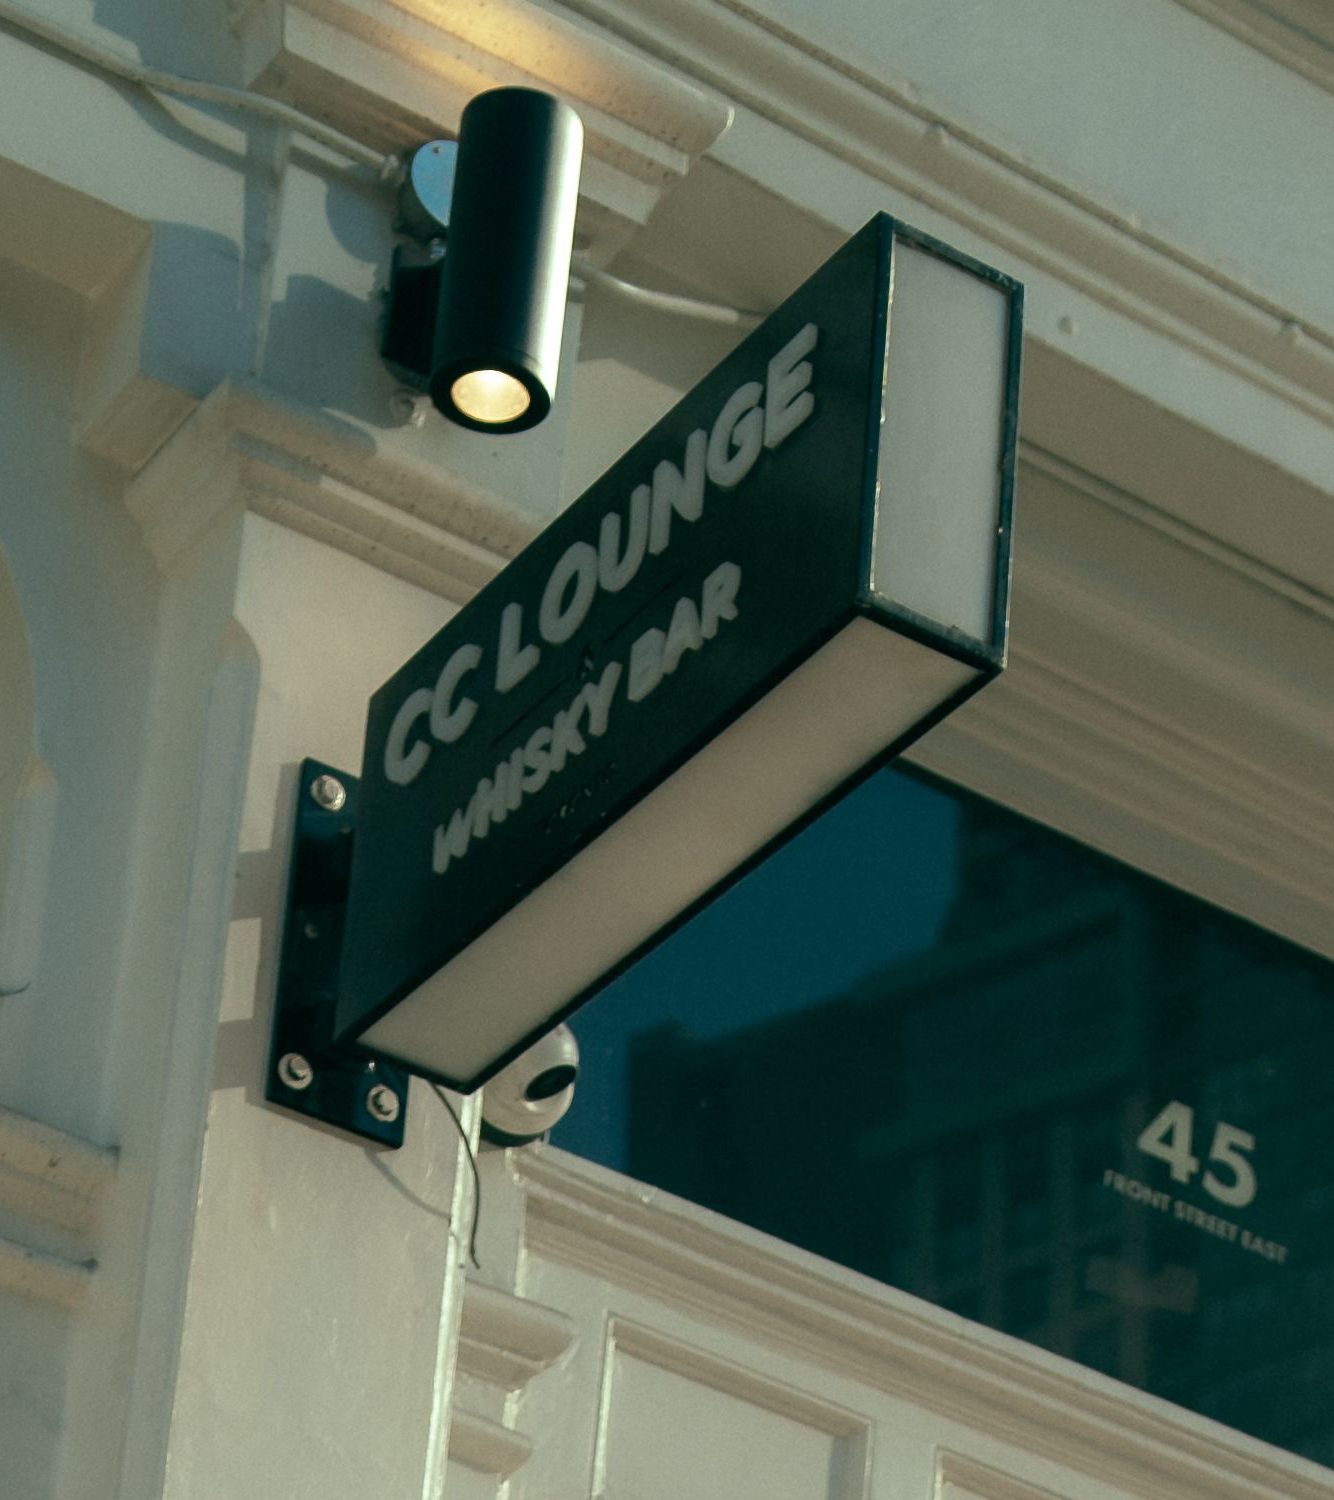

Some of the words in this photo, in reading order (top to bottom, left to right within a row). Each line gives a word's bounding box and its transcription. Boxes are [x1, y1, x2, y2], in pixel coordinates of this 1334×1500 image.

[383, 644, 483, 785] CC
[494, 323, 819, 693] LOUNGE
[430, 661, 623, 875] WHISKY
[626, 561, 742, 703] BAR
[1104, 1169, 1170, 1210] FRONT
[1174, 1201, 1238, 1242] STREET
[1241, 1230, 1287, 1264] EAST
[1136, 1100, 1258, 1209] 45
